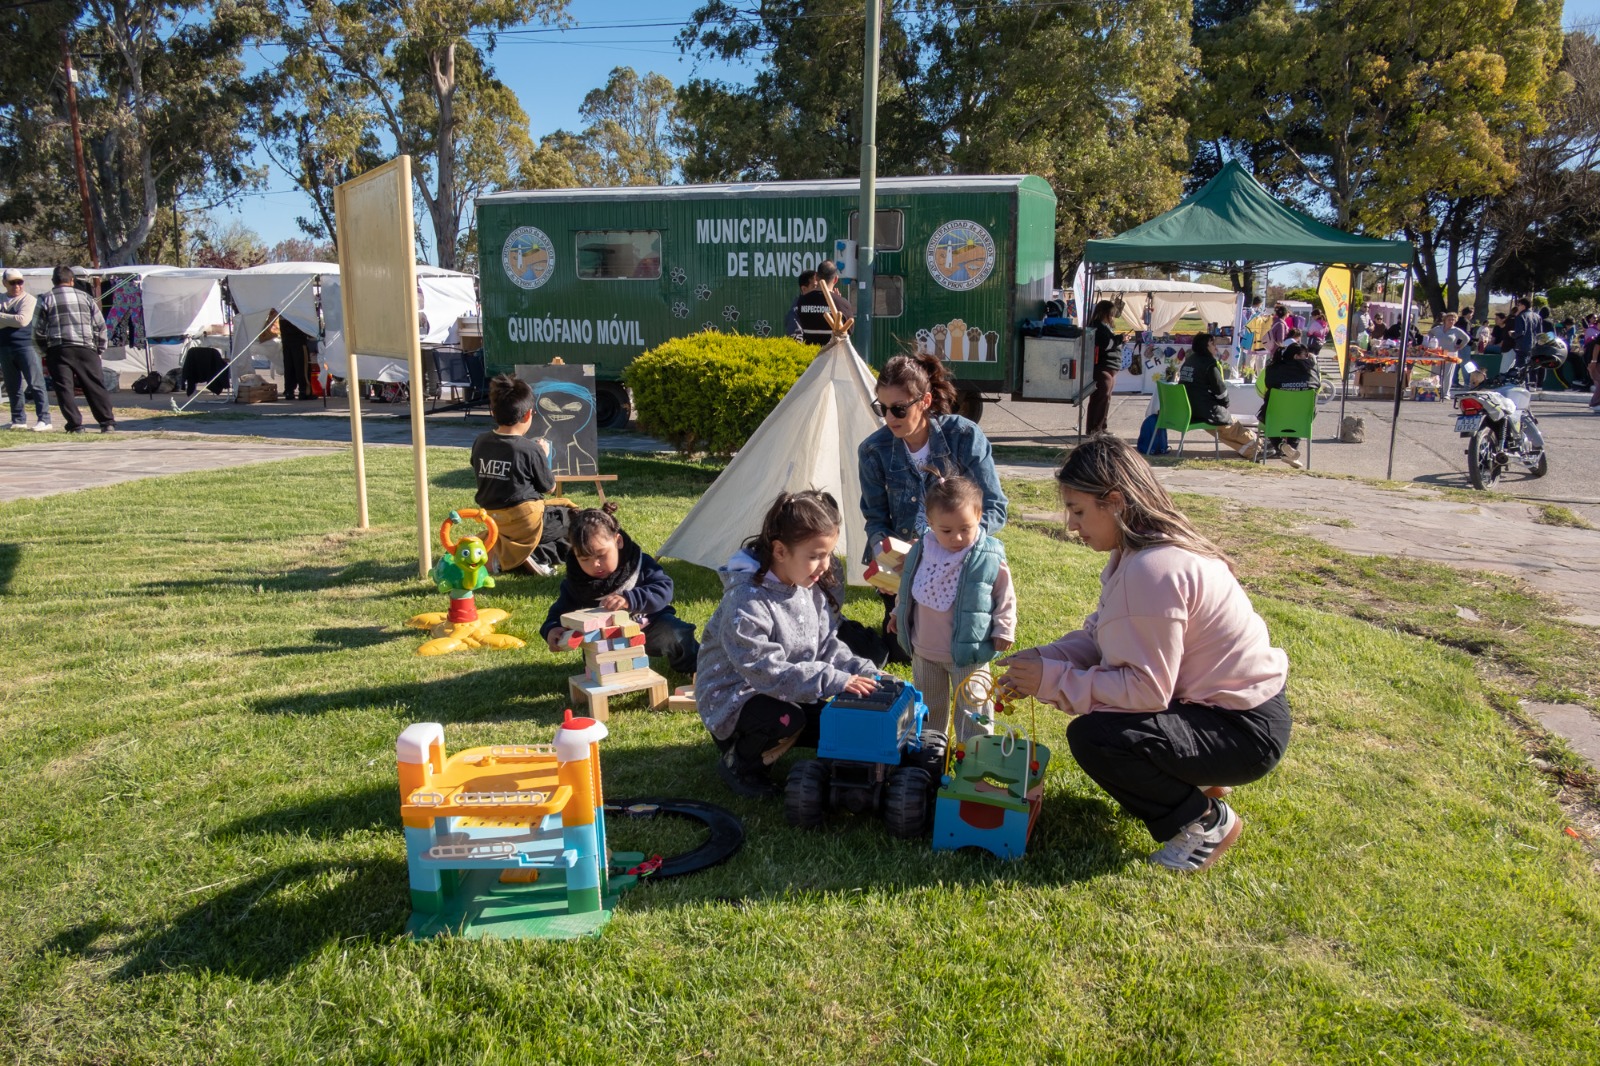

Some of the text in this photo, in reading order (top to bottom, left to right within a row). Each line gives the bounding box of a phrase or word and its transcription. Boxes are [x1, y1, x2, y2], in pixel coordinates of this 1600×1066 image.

[696, 217, 828, 244] MUNICIPALIDAD
[727, 252, 749, 277] DE
[508, 311, 645, 346] QUIRÓFANO MÓVIL
[479, 458, 512, 477] MEF
